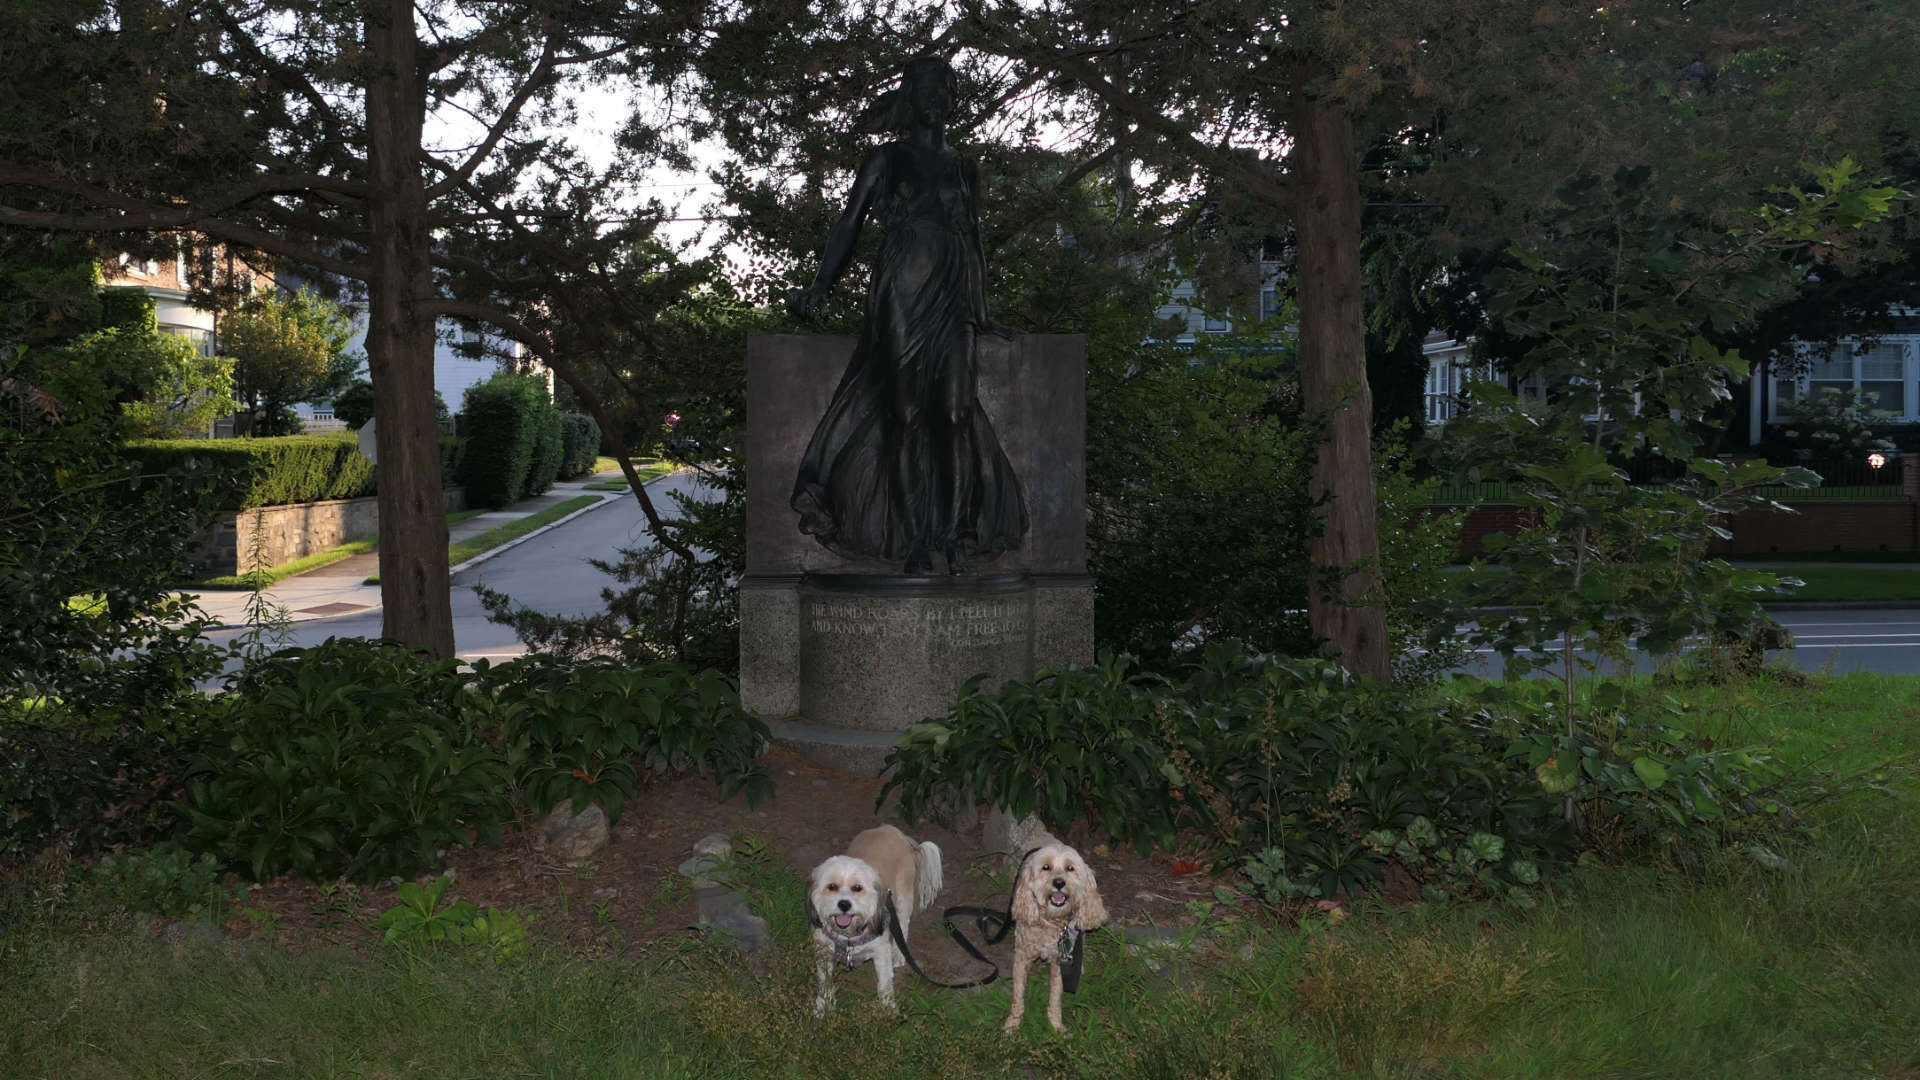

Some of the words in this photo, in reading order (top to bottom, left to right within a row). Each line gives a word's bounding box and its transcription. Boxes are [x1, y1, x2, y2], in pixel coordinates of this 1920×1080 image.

[830, 605, 863, 619] WIND
[812, 620, 831, 633] AND
[834, 622, 877, 636] KNOW
[967, 622, 997, 635] FREE
